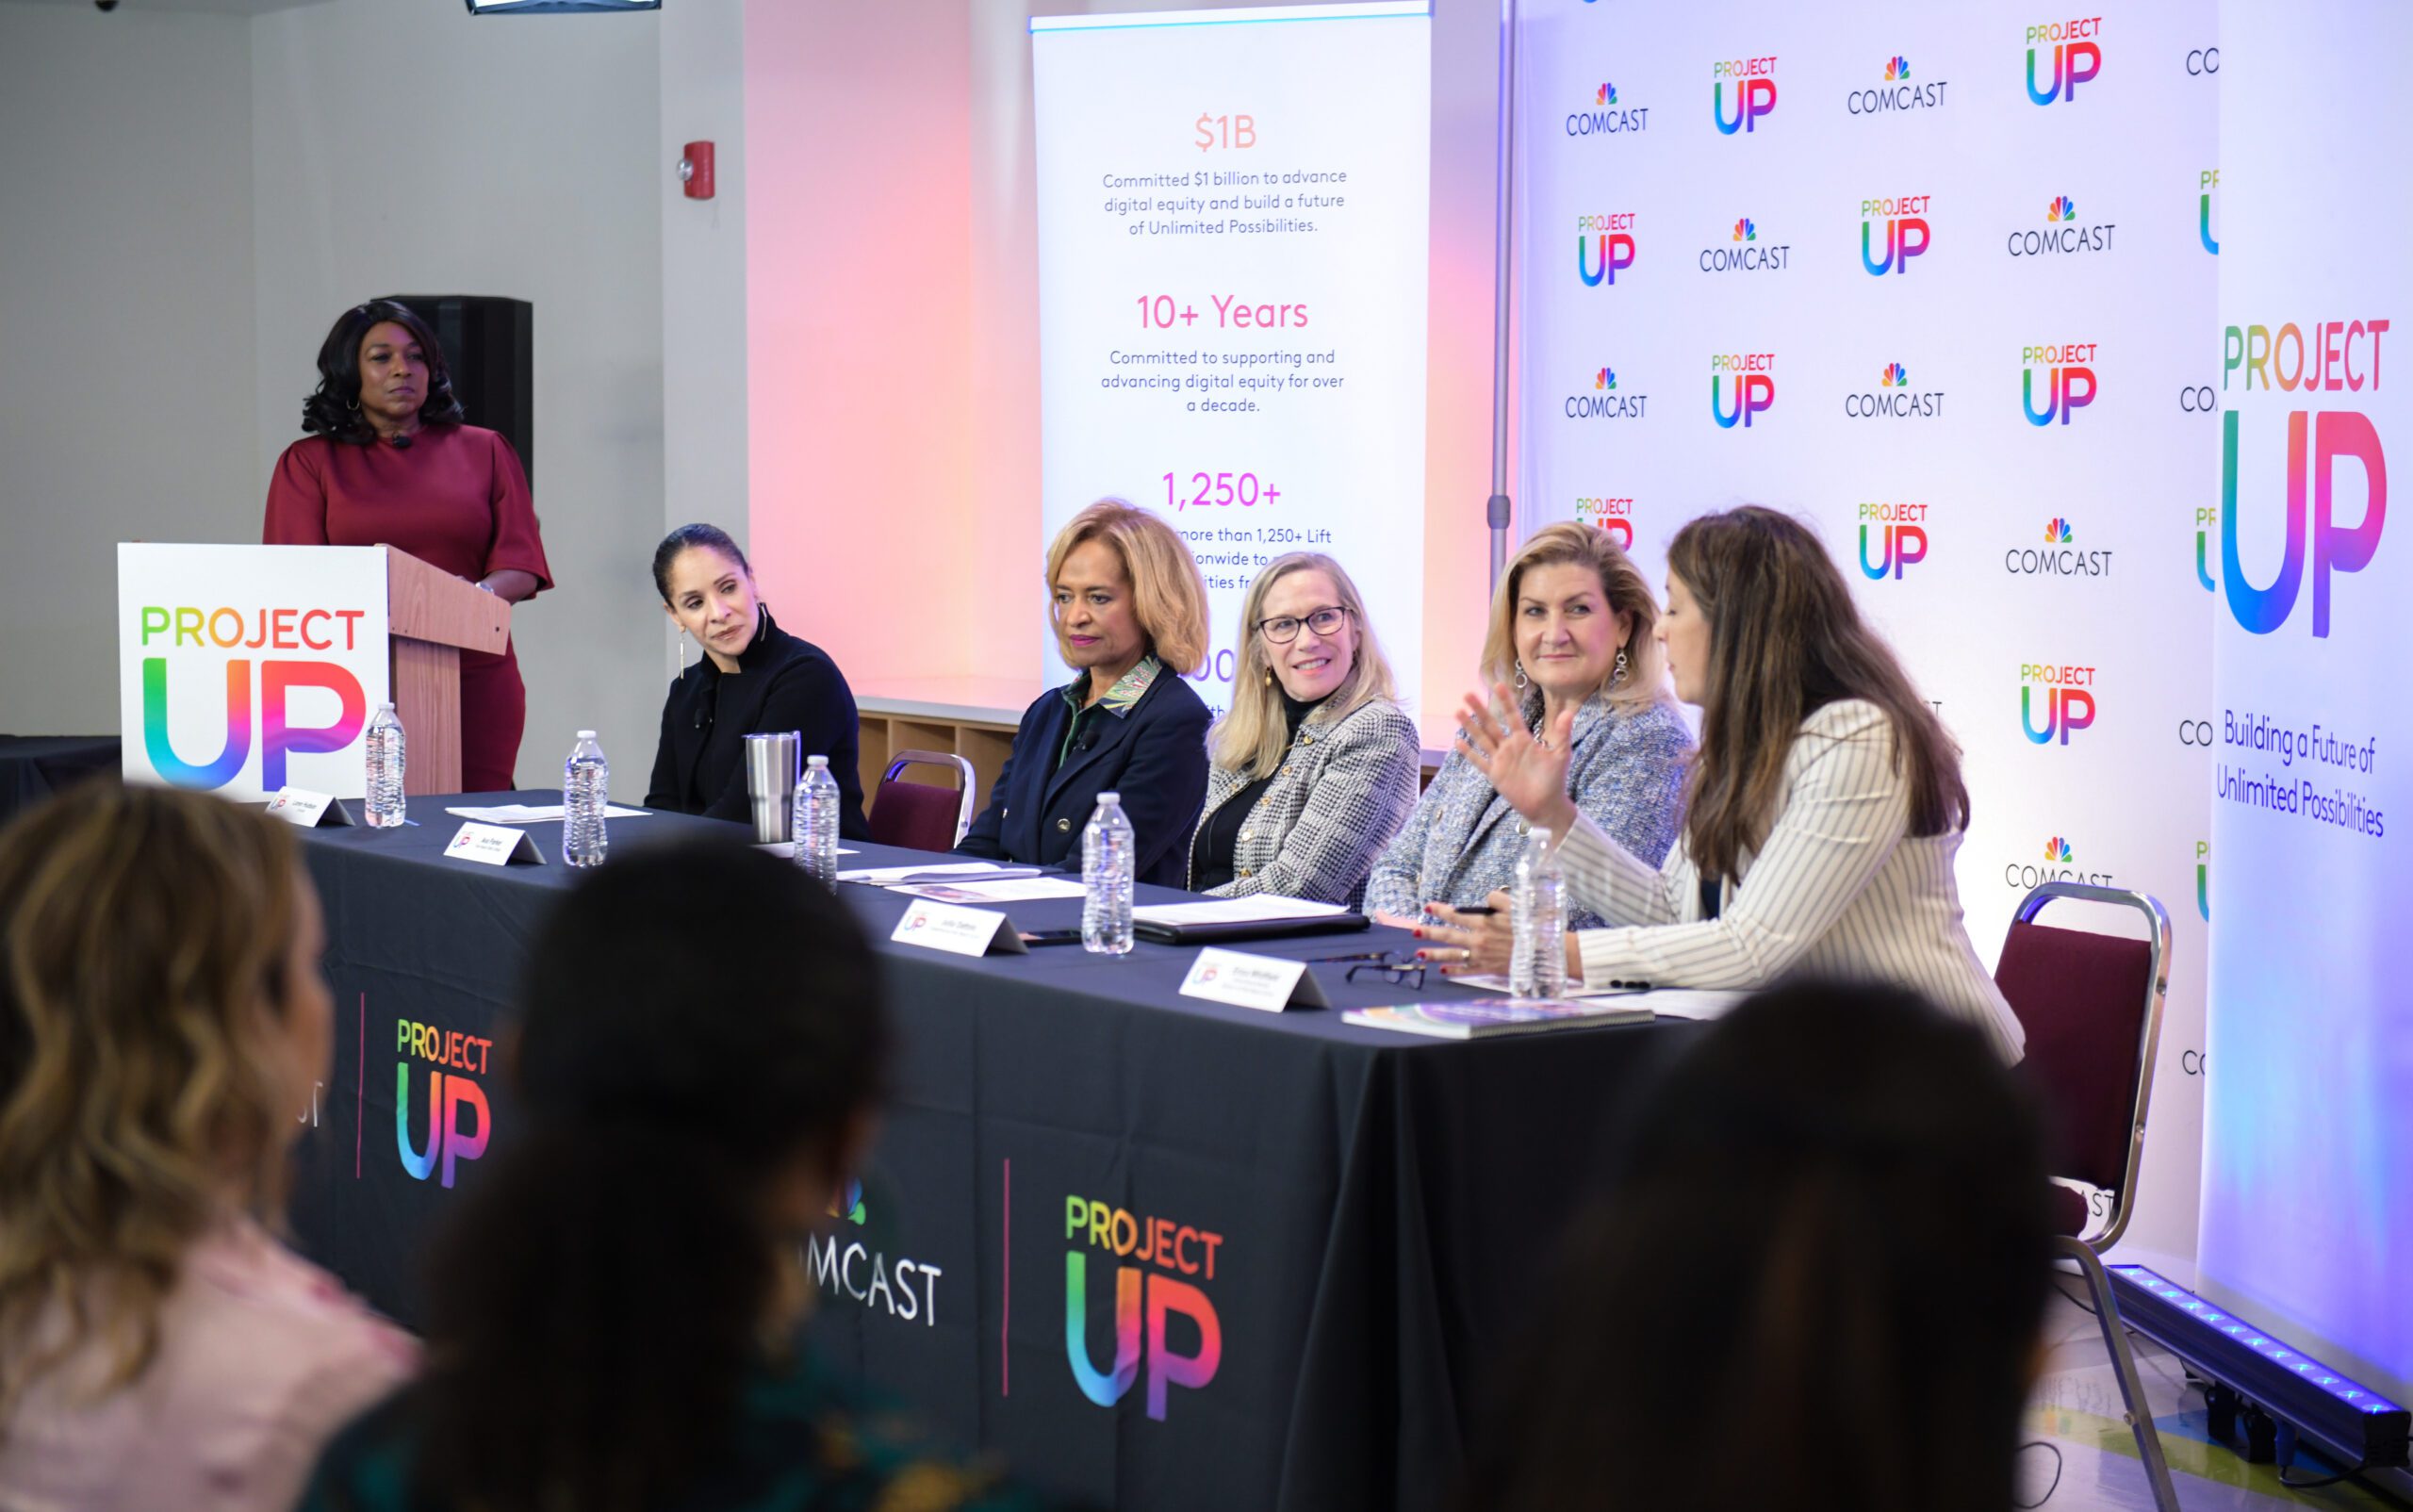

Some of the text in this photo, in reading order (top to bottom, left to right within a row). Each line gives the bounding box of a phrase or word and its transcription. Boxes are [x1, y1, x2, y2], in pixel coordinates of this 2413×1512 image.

[2027, 17, 2102, 44] PROJECT
[1714, 57, 1778, 78] PROJECT
[2027, 41, 2102, 107] UP
[1715, 78, 1778, 136] UP
[1848, 81, 1947, 115] COMCAST
[1194, 112, 1257, 153] $1B
[1566, 108, 1650, 137] COMCAST
[1102, 169, 1348, 189] Committed $1 billion to advance
[1104, 193, 1345, 216] digital equity and build a future
[1861, 195, 1931, 218] PROJECT
[1129, 218, 1319, 236] of Unlimited Possibilities.
[1578, 213, 1636, 232] PROJECT
[1862, 218, 1931, 276] UP
[2008, 224, 2116, 256] COMCAST
[1579, 234, 1636, 288] UP
[1699, 246, 1791, 272] COMCAST
[1137, 294, 1309, 329] 10+ Years
[1109, 349, 1336, 368] Committed to supporting and
[1712, 353, 1775, 371] PROJECT
[2023, 344, 2097, 364] PROJECT
[2224, 320, 2390, 392] PROJECT
[1101, 373, 1345, 392] advancing digital equity for over
[2023, 367, 2097, 426] UP
[1187, 398, 1260, 412] a decade.
[1566, 395, 1649, 419] COMCAST
[1713, 374, 1775, 429] UP
[1845, 392, 1945, 418] COMCAST
[1162, 471, 1282, 512] 1,250+
[1576, 498, 1633, 515] PROJECT
[1859, 503, 1929, 522] PROJECT
[2222, 410, 2388, 639] UP
[1218, 527, 1253, 542] than
[1256, 528, 1303, 544] 1,250+
[1307, 529, 1332, 544] Lift
[1253, 553, 1269, 567] to
[1859, 524, 1929, 581] UP
[2005, 550, 2113, 577] COMCAST
[141, 606, 365, 650] PROJECT
[2021, 664, 2096, 686] PROJECT
[142, 657, 367, 792] UP
[2021, 685, 2096, 746] UP
[2224, 709, 2293, 766] Building
[2297, 731, 2308, 758] a
[2312, 724, 2357, 770] Future
[2359, 737, 2375, 774] of
[2218, 763, 2384, 838] Unlimited Possibilities
[397, 1019, 493, 1075] PROJECT
[396, 1061, 491, 1190] UP
[1066, 1194, 1223, 1280] PROJECT
[806, 1230, 942, 1326] MCAST
[1066, 1250, 1223, 1422] UP
